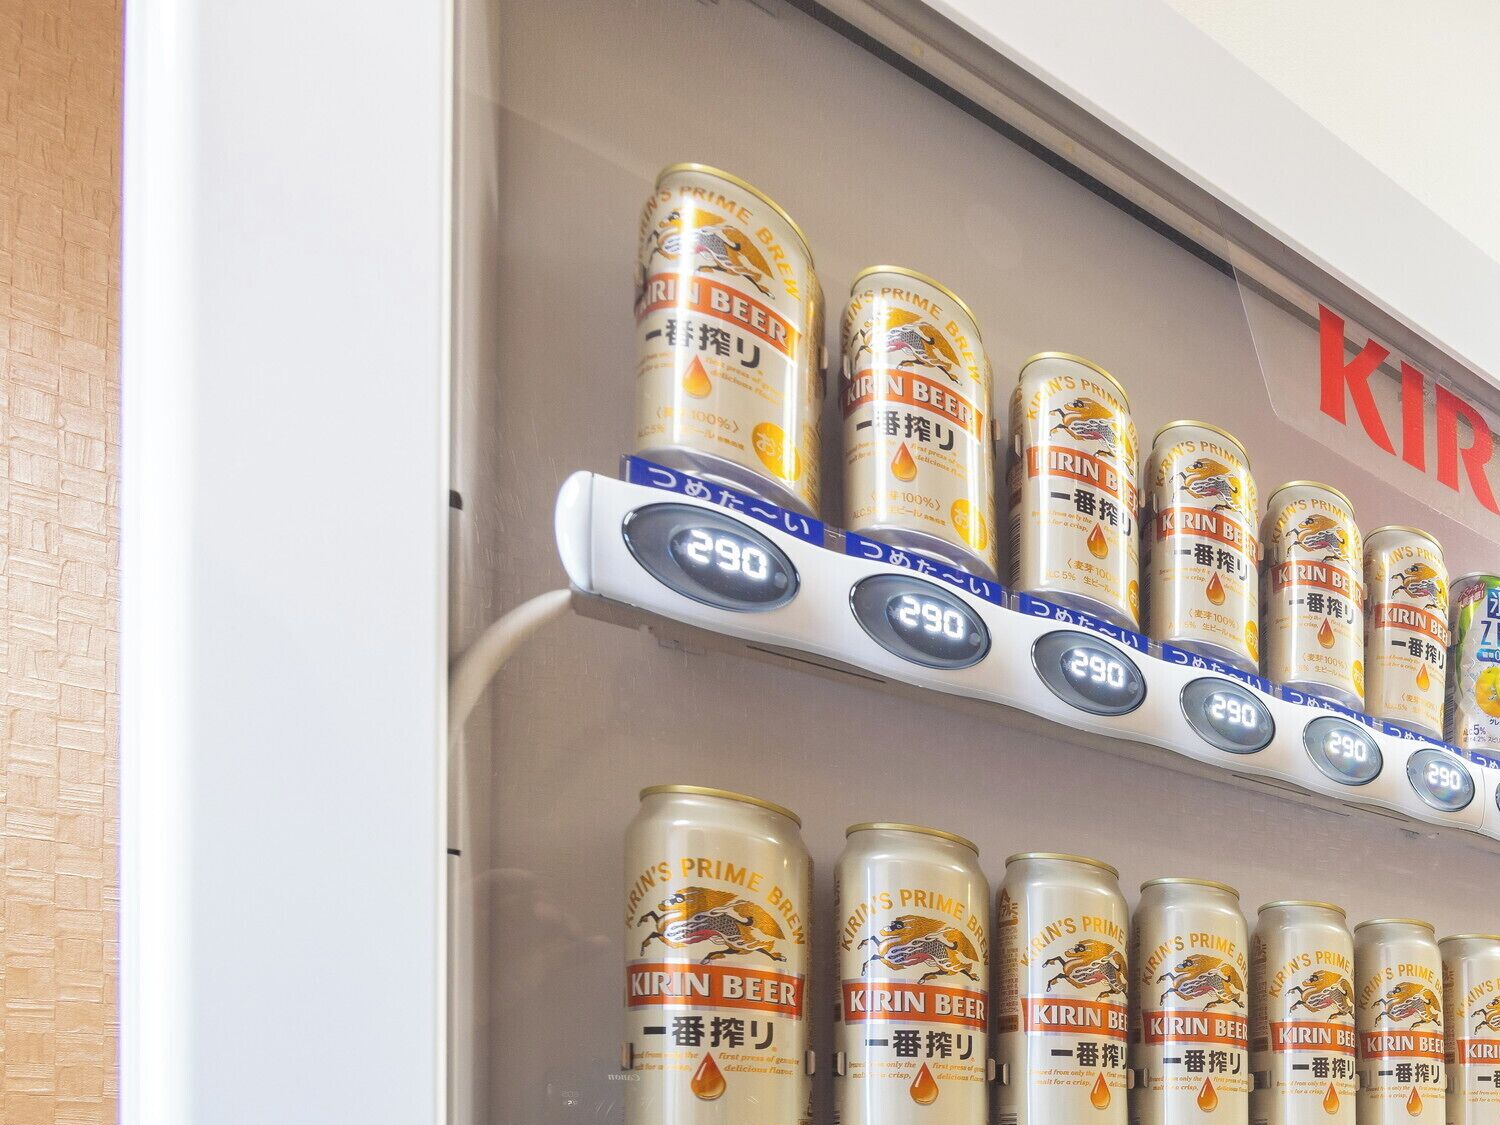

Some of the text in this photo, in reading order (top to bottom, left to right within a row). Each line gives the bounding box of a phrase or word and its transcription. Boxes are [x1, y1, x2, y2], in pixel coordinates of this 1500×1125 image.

[680, 185, 800, 301] PRIME BREW
[711, 287, 788, 348] BEER
[645, 319, 760, 369] 一番搾り
[881, 287, 982, 385] PRIME BREW
[856, 411, 954, 451] 一番搾り
[1200, 440, 1243, 473] PRIME
[1050, 489, 1131, 536] 一番搾り
[687, 533, 767, 580] 290
[1174, 543, 1248, 581] 一番搾り
[899, 598, 964, 642] 290
[1289, 593, 1354, 624] 一番搾り
[1070, 651, 1124, 688] 290
[1212, 693, 1256, 728] 290
[1329, 731, 1367, 762] 290
[1428, 765, 1460, 790] 290
[625, 858, 806, 946] KIRIN'S PRIME BREW
[841, 893, 893, 952] KIRIN'S
[900, 889, 966, 921] PRIME
[1020, 916, 1125, 967] KIRIN'S PRIME
[1190, 933, 1236, 957] PRIME
[1315, 951, 1350, 972] PRIME
[1398, 963, 1434, 982] PRIME
[631, 971, 797, 1007] KIRIN BEER
[849, 990, 985, 1021] KIRIN BEER
[643, 1016, 774, 1048] 一番搾り
[1033, 1005, 1102, 1028] KIRIN
[1150, 1016, 1208, 1037] KIRIN
[864, 1030, 974, 1059] 一番搾り
[1279, 1027, 1332, 1045] KIRIN
[1367, 1036, 1414, 1053] KIRIN
[1163, 1050, 1241, 1075] 一番搾り
[1378, 1063, 1440, 1084] 一番搾り
